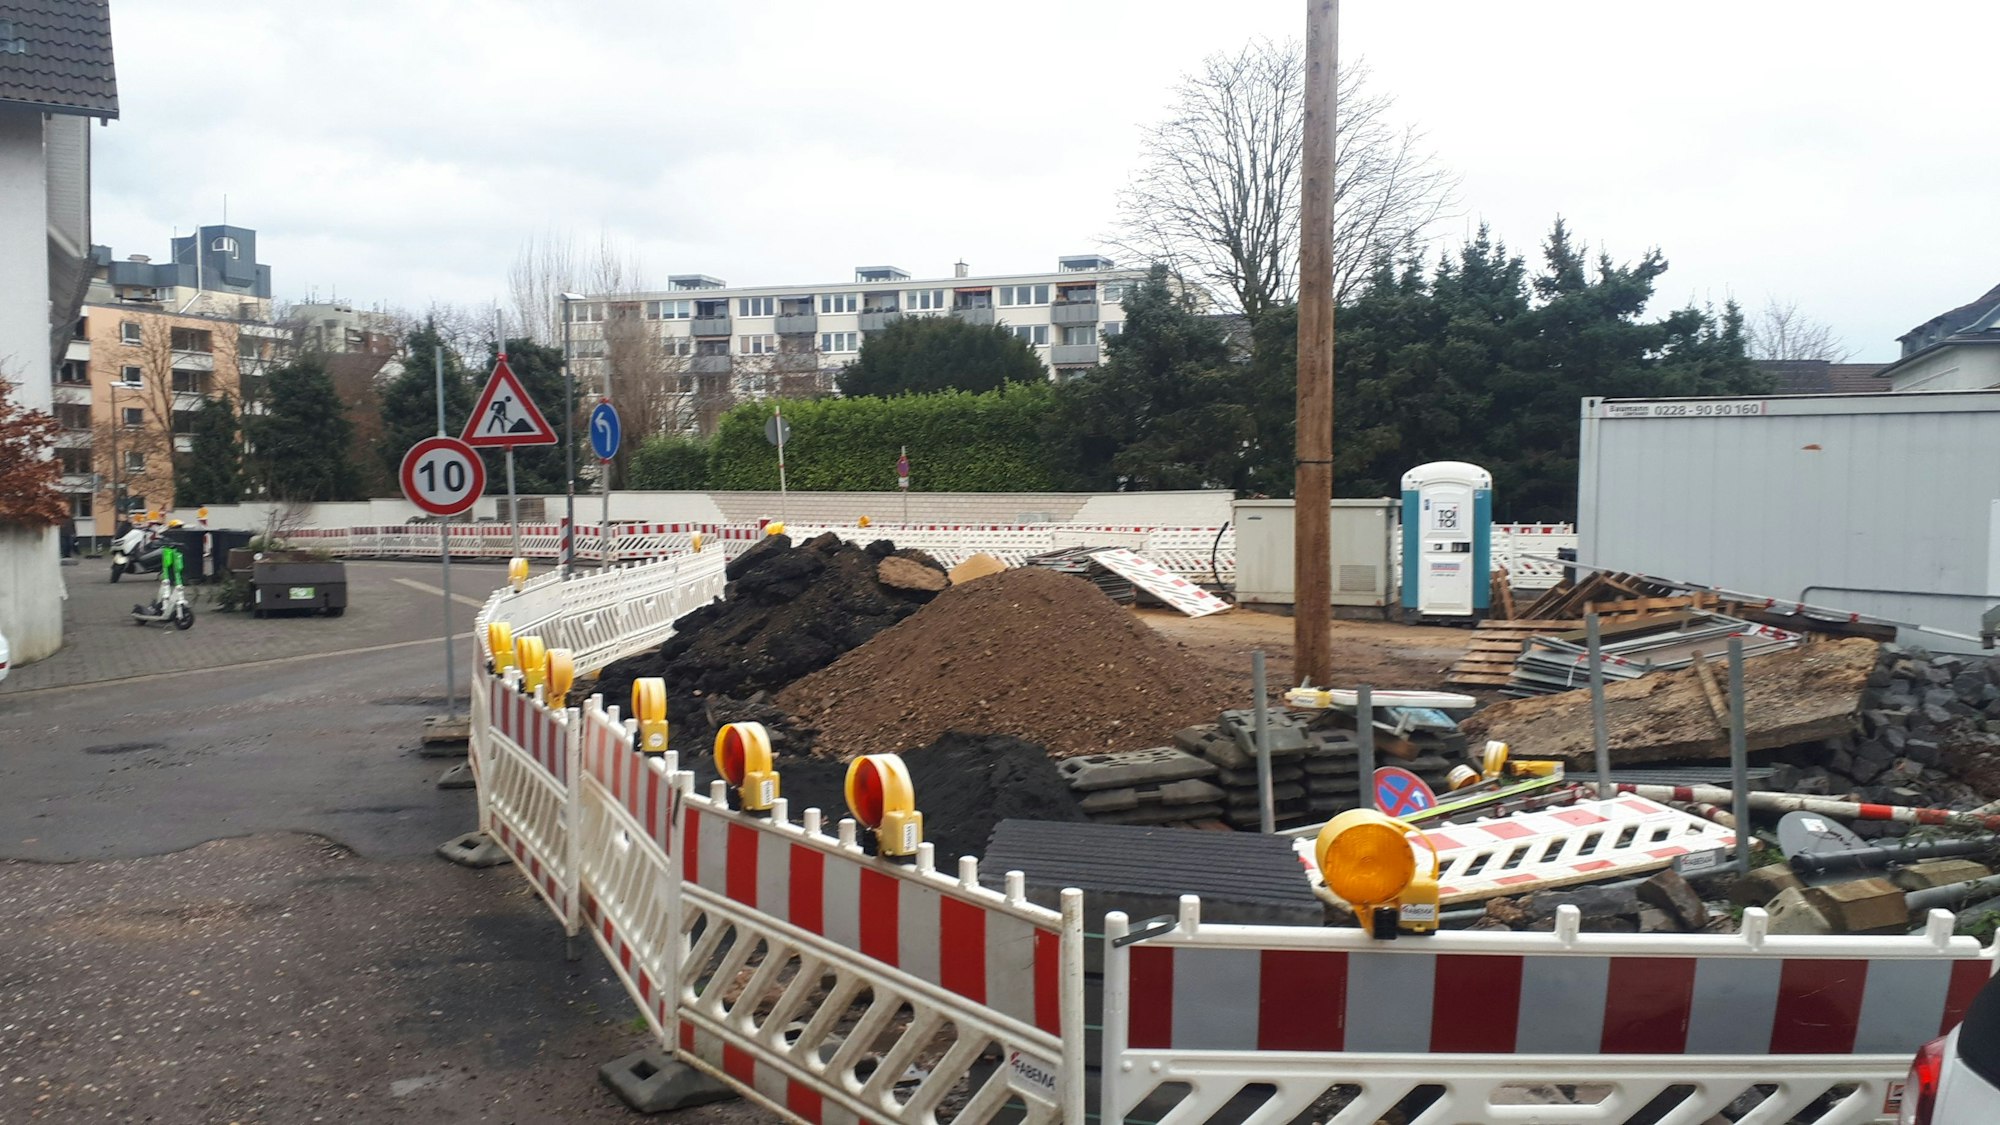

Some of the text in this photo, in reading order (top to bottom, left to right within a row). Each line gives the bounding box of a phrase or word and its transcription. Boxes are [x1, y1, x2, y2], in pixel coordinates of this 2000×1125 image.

[1655, 405, 1686, 416] 0228
[1696, 405, 1713, 415] 90
[1715, 404, 1732, 415] 90
[1735, 403, 1759, 414] 160
[419, 460, 465, 492] 10
[1438, 519, 1457, 528] TOI
